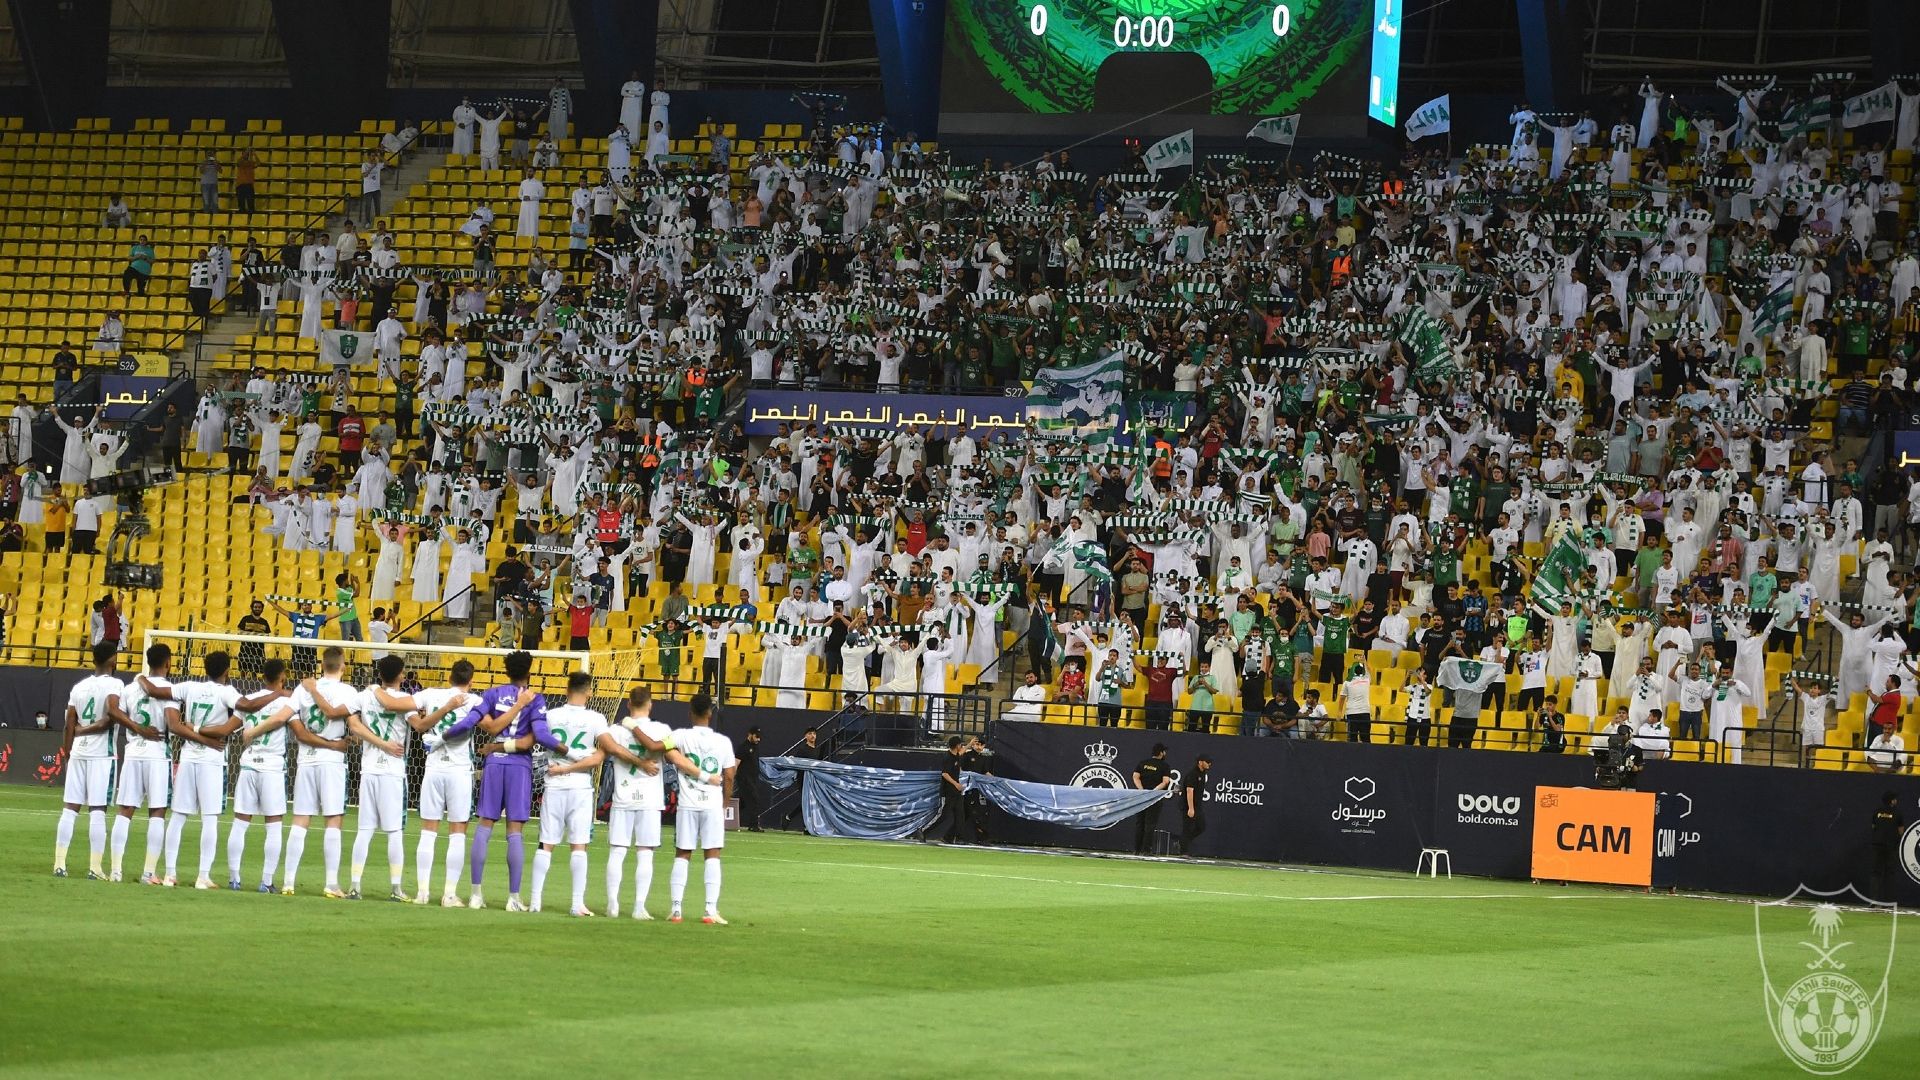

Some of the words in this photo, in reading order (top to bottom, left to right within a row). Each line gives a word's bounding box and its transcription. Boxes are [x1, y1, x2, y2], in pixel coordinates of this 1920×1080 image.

[1030, 5, 1047, 35] 0
[1114, 16, 1174, 47] 0:00
[1272, 5, 1290, 36] 0
[120, 361, 135, 371] S26
[104, 389, 164, 407] نصر
[1005, 388, 1023, 397] S27
[750, 404, 817, 423] النصر
[822, 406, 890, 425] النصر
[1608, 608, 1654, 618] AL-AHLI
[82, 697, 97, 724] 4
[136, 697, 151, 728] 5
[191, 702, 214, 727] 17
[307, 704, 325, 734] 8
[433, 706, 457, 732] 8
[628, 744, 647, 776] 7
[1081, 770, 1118, 785] ALNASSR
[1215, 793, 1264, 806] MRSOOL
[1457, 813, 1519, 826] bold.com.sa
[1556, 823, 1631, 854] CAM
[1657, 828, 1676, 857] CAM
